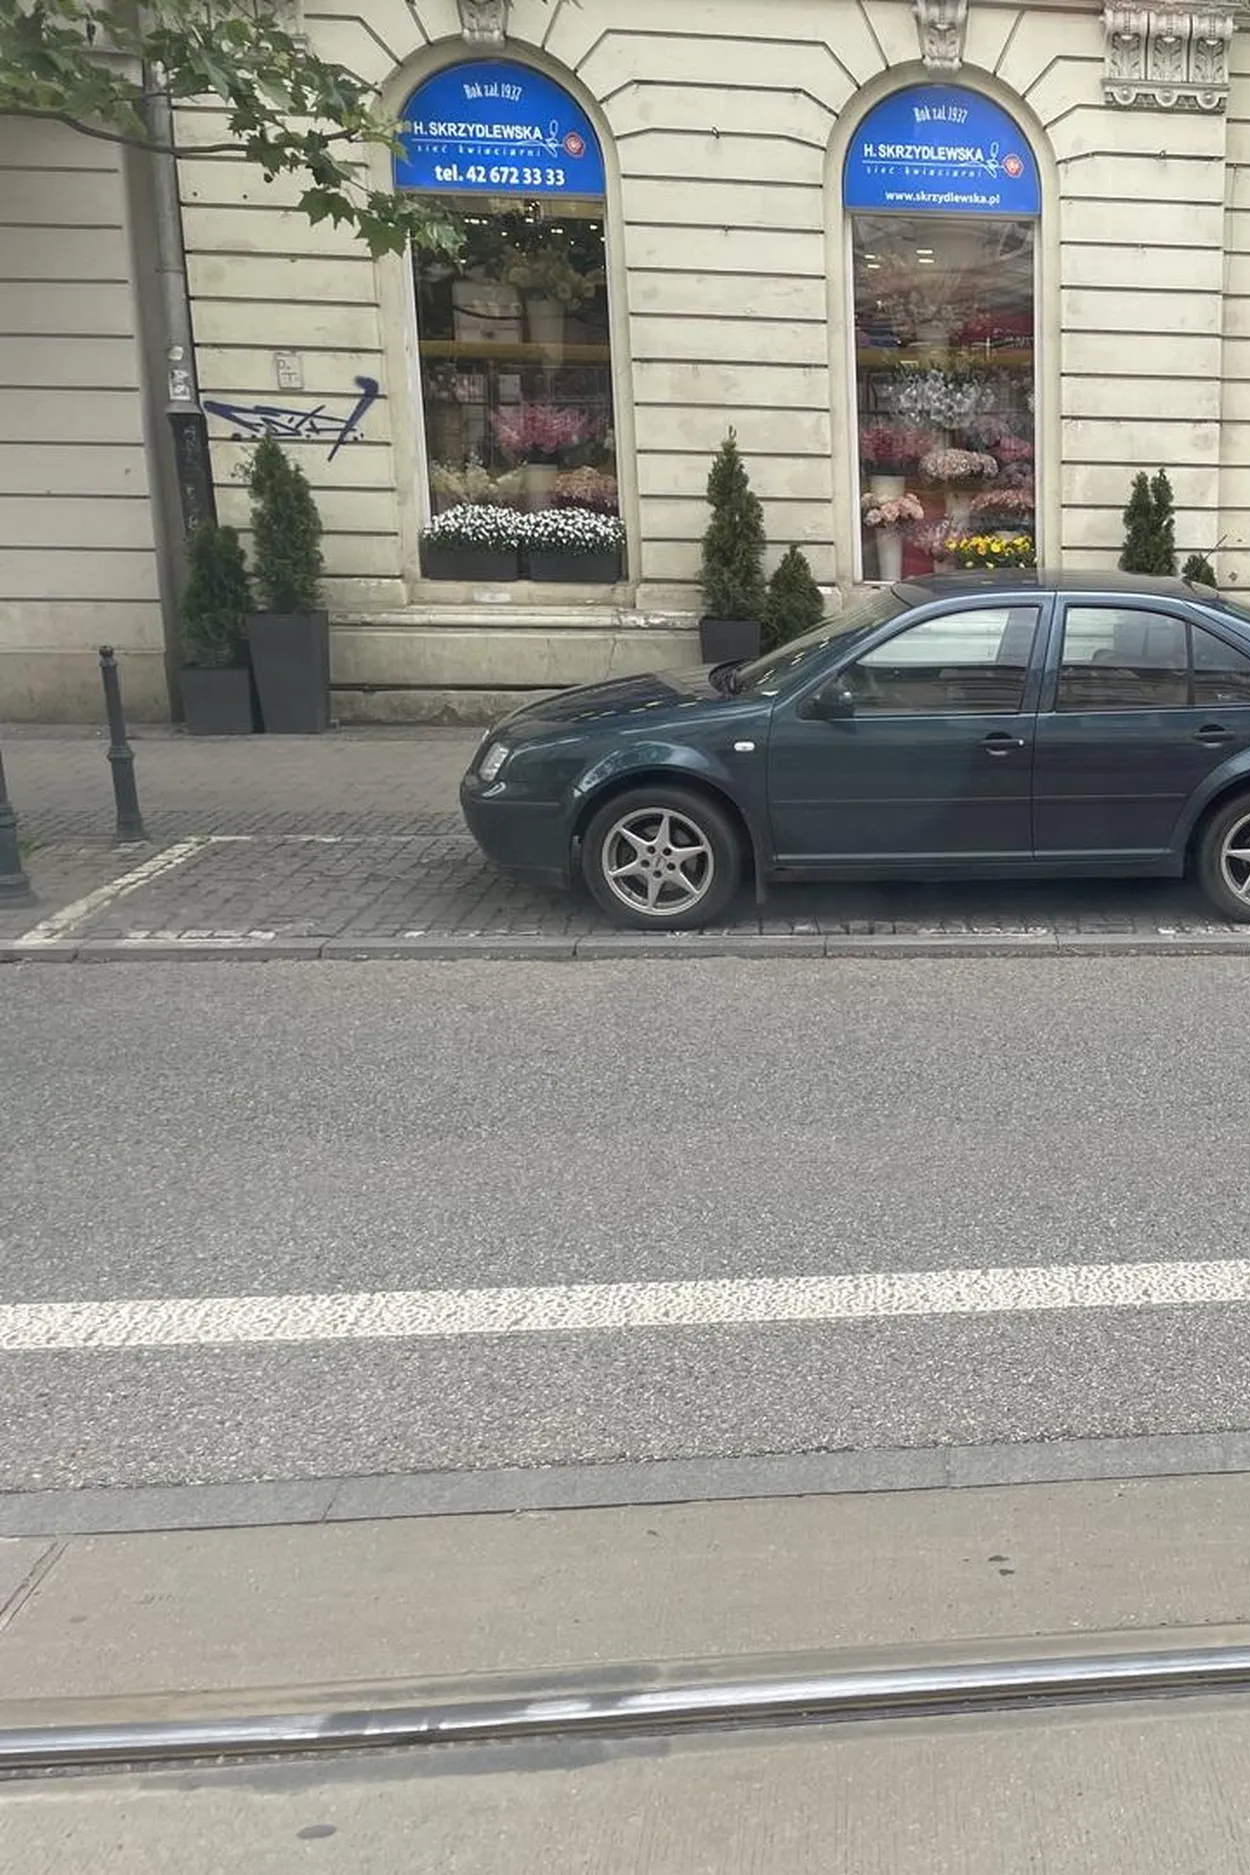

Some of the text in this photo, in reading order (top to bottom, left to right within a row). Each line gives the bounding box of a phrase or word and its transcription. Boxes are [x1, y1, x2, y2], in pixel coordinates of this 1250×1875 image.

[463, 83, 482, 100] Rok
[501, 83, 522, 101] 1937
[913, 105, 931, 123] Rok
[947, 105, 968, 124] 1937
[434, 164, 565, 186] tel. 42 672 33 33
[885, 190, 1000, 206] www.skrzydlewska.pl
